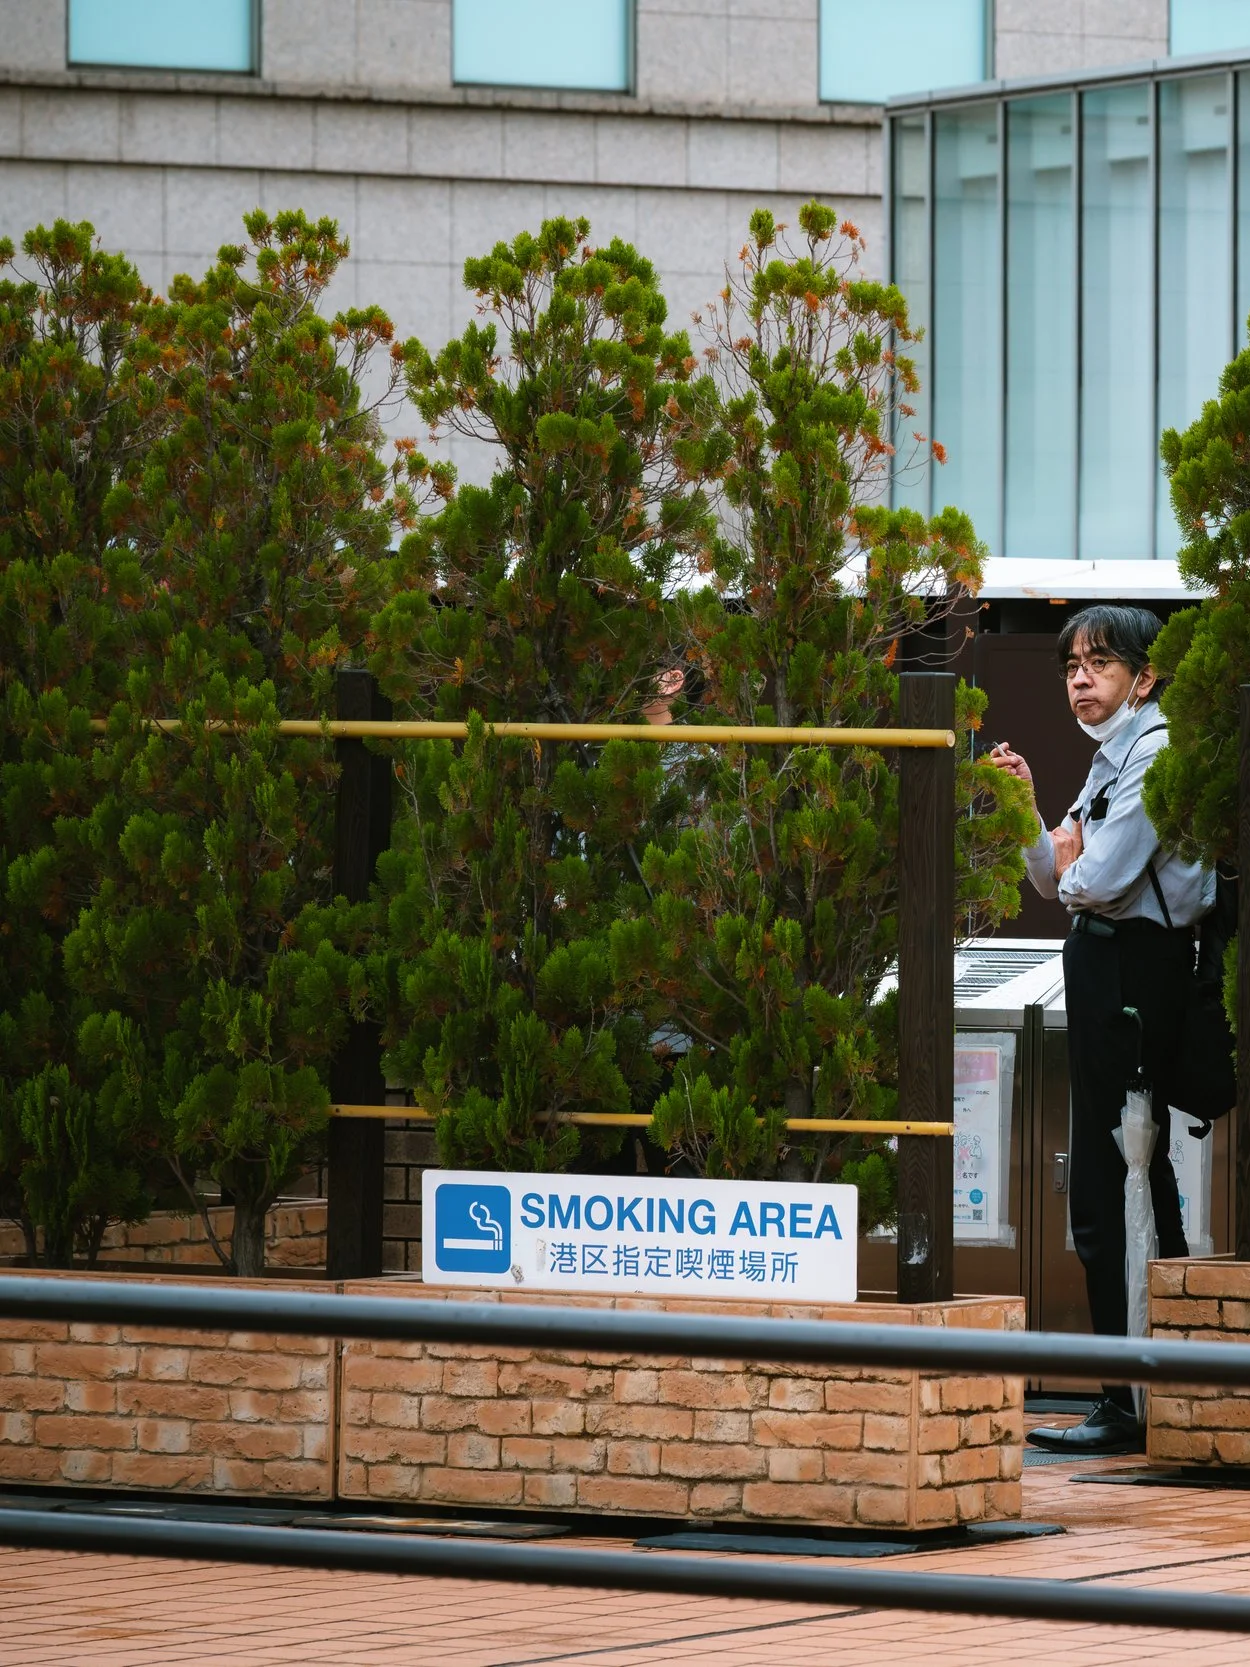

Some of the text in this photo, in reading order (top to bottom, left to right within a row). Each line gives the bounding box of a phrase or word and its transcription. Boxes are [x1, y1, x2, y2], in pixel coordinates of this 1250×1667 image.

[520, 1192, 842, 1240] SMOKING AREA
[549, 1242, 799, 1284] 港区指定喫煙場所
